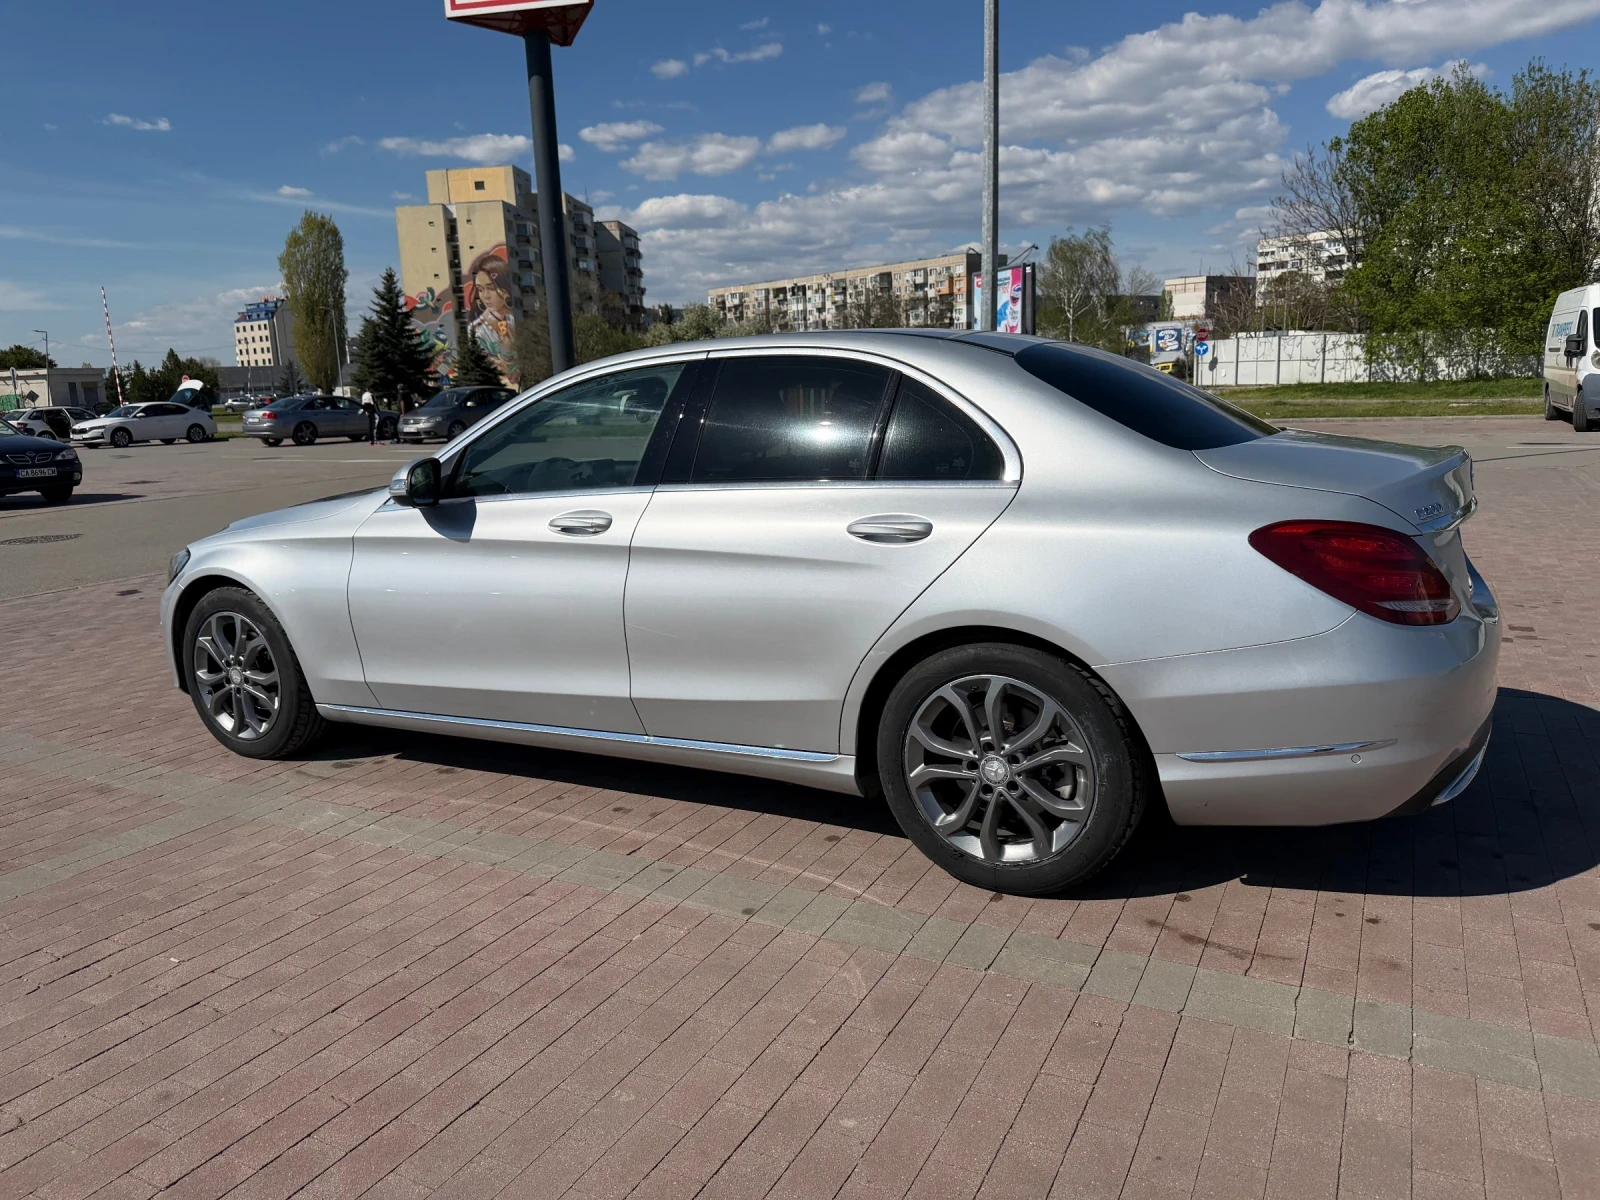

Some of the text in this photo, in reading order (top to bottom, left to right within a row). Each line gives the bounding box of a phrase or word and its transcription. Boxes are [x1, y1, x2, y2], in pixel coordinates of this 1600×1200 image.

[20, 468, 57, 477] CA 8696 CM
